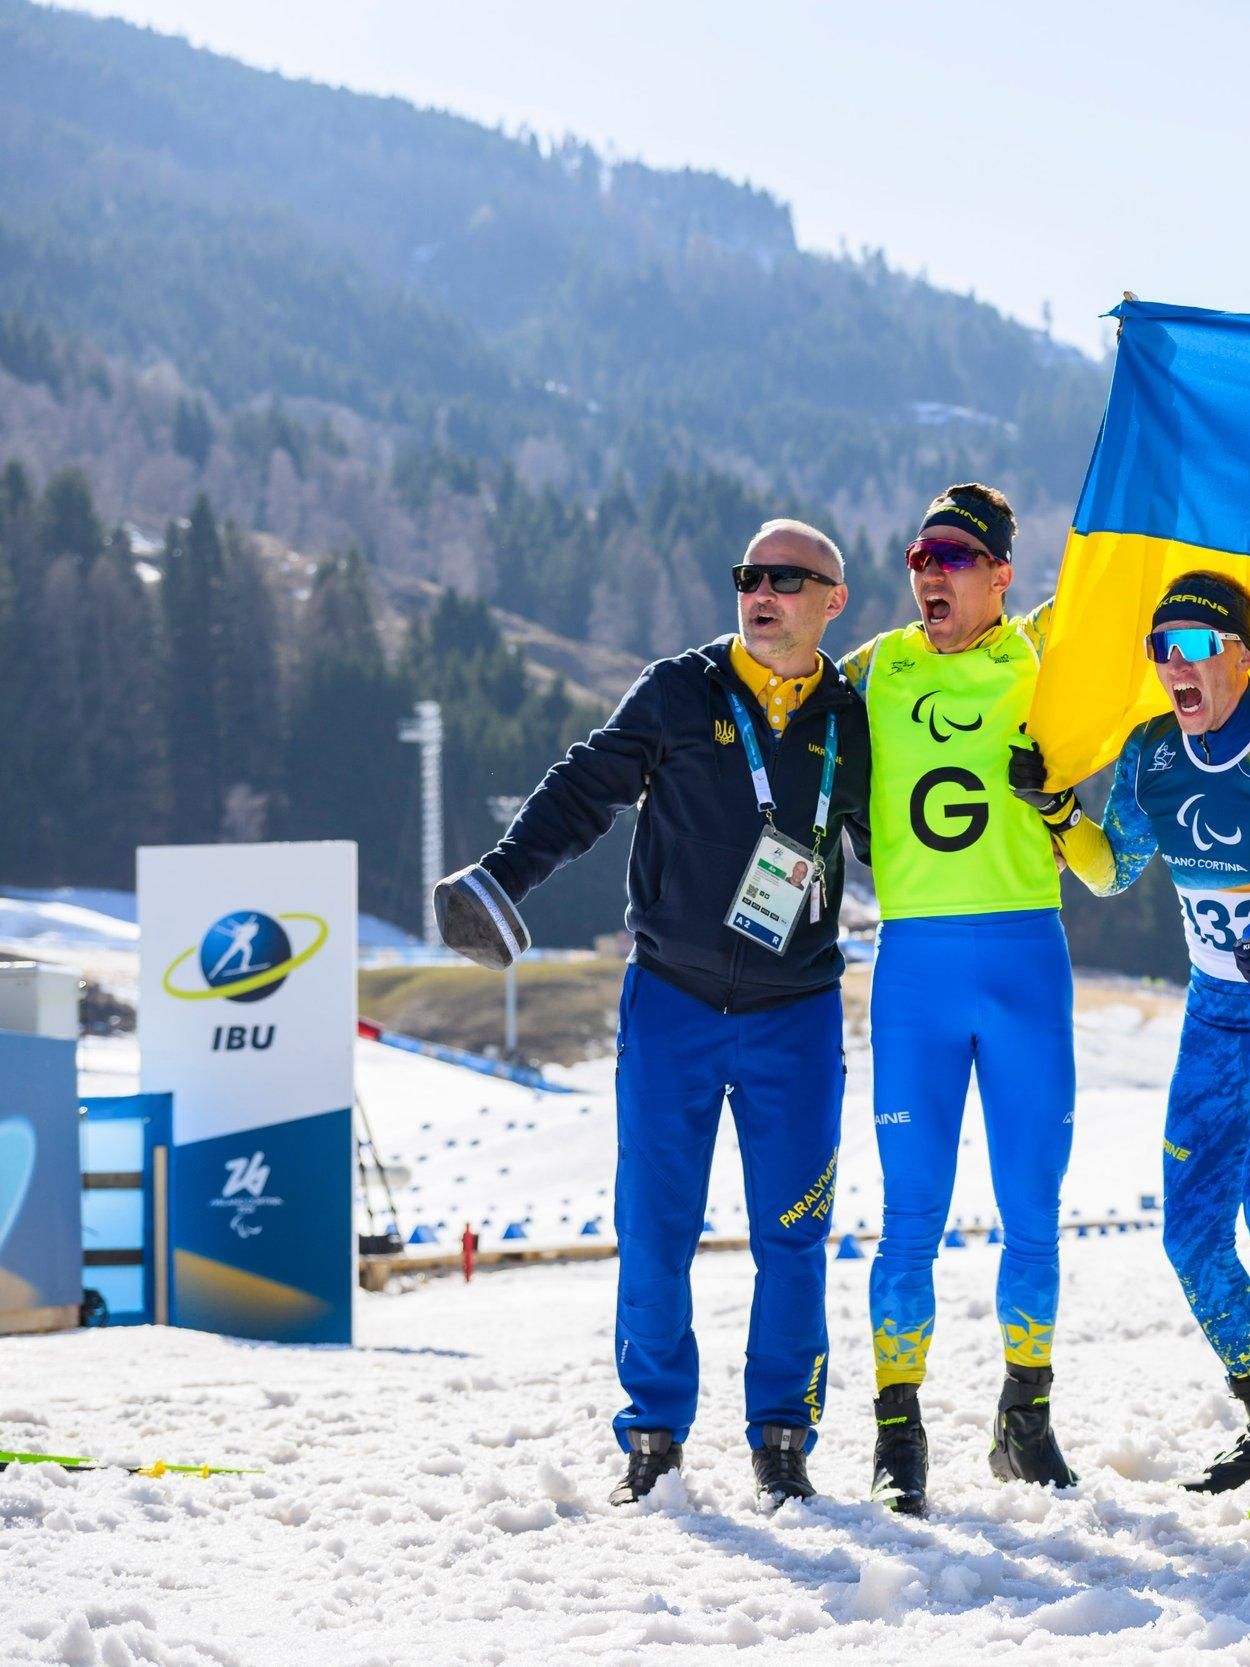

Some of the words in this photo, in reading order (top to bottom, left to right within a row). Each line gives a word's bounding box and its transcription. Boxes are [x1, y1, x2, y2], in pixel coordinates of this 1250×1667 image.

[1158, 594, 1230, 616] KRAINE
[808, 743, 843, 766] UKRE
[909, 766, 989, 853] G
[1162, 853, 1196, 867] MILANO
[1197, 858, 1248, 873] CORTINA
[771, 936, 779, 945] R
[212, 1024, 276, 1051] IBU
[875, 1111, 911, 1126] AINE
[804, 1353, 826, 1424] RAINE
